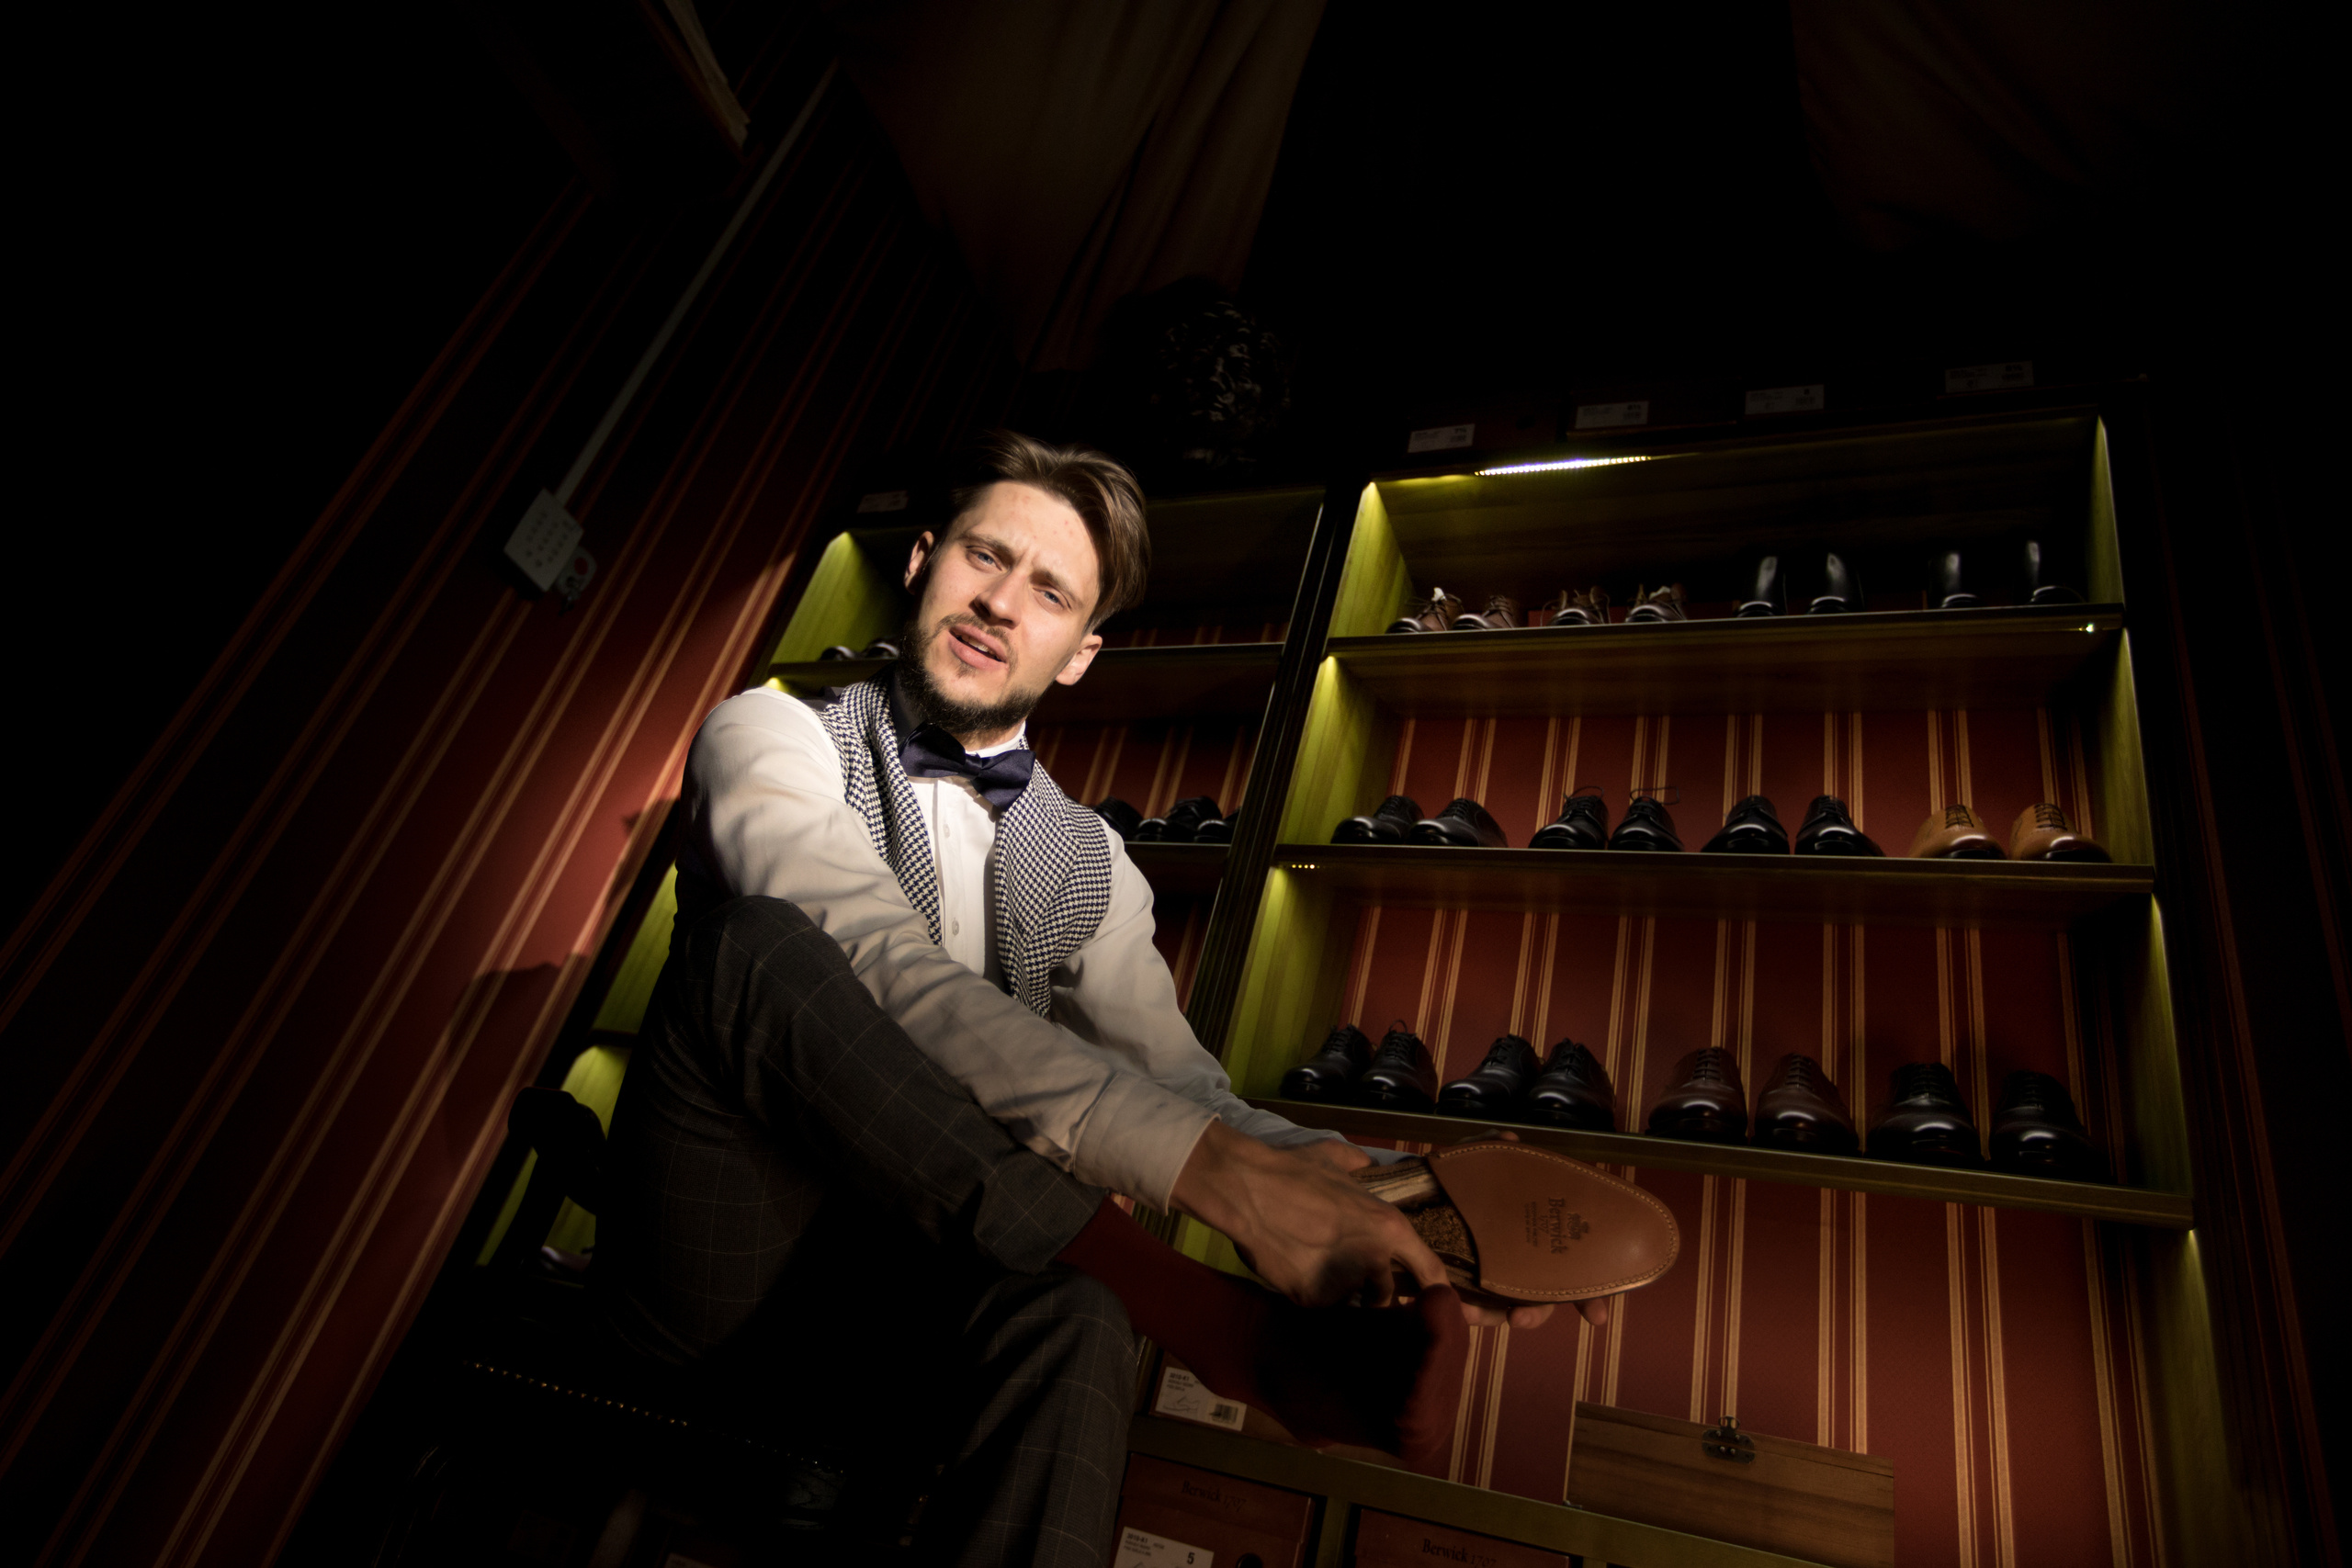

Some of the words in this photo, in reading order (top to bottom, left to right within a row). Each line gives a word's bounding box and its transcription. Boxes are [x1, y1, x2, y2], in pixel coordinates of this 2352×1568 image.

[1548, 1197, 1568, 1254] Berwick
[1181, 1481, 1221, 1503] Berwick
[1223, 1495, 1247, 1512] 1707
[1187, 1551, 1195, 1564] 5
[1422, 1539, 1469, 1562] Berwick
[1470, 1554, 1498, 1568] 1707
